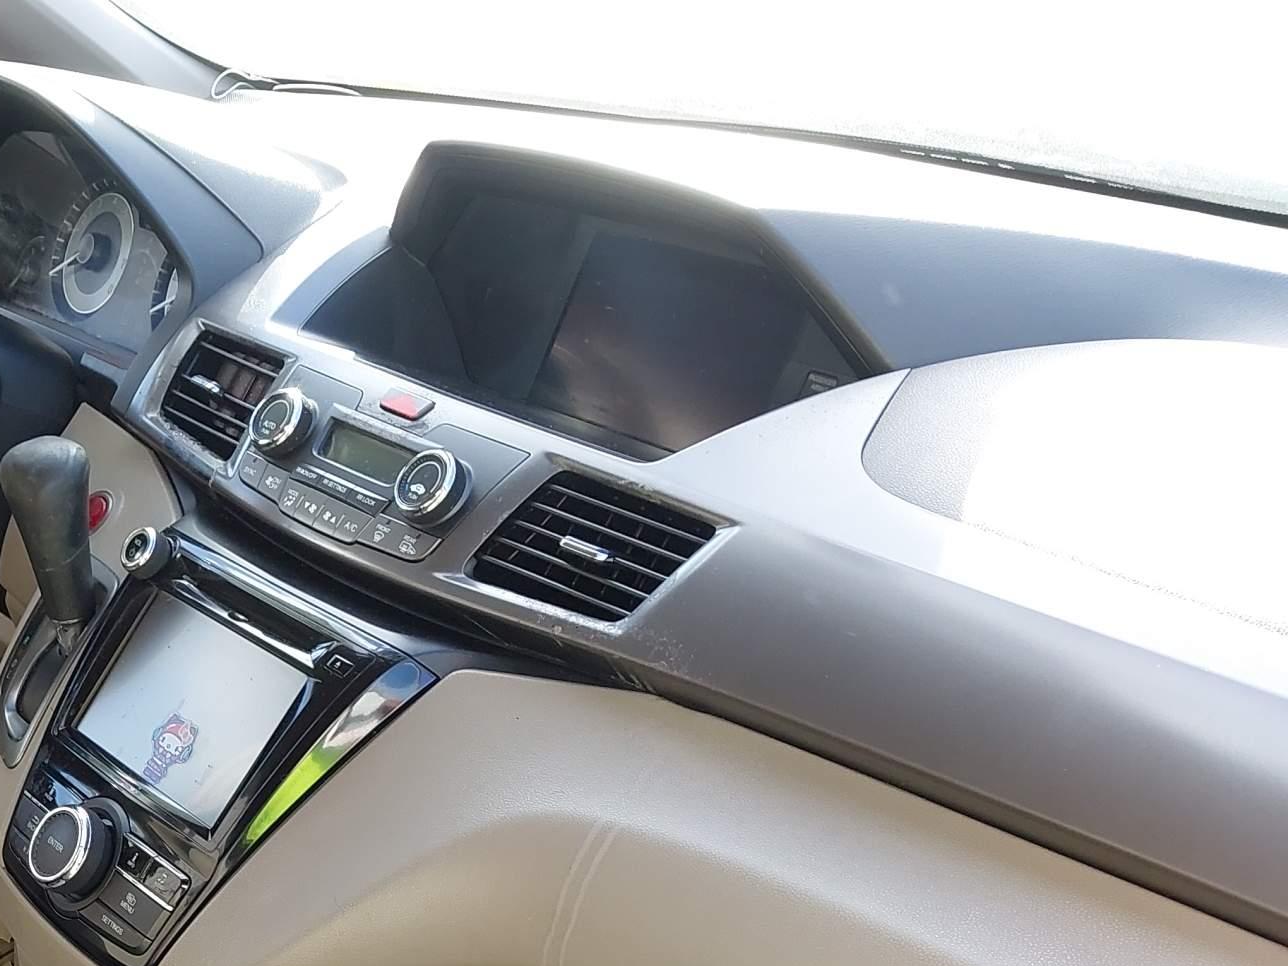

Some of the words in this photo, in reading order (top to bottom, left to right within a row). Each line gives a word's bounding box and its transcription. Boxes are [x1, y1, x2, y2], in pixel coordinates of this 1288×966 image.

[47, 836, 64, 853] ENTER
[120, 900, 134, 914] MENU
[101, 914, 124, 936] SETTINGS
